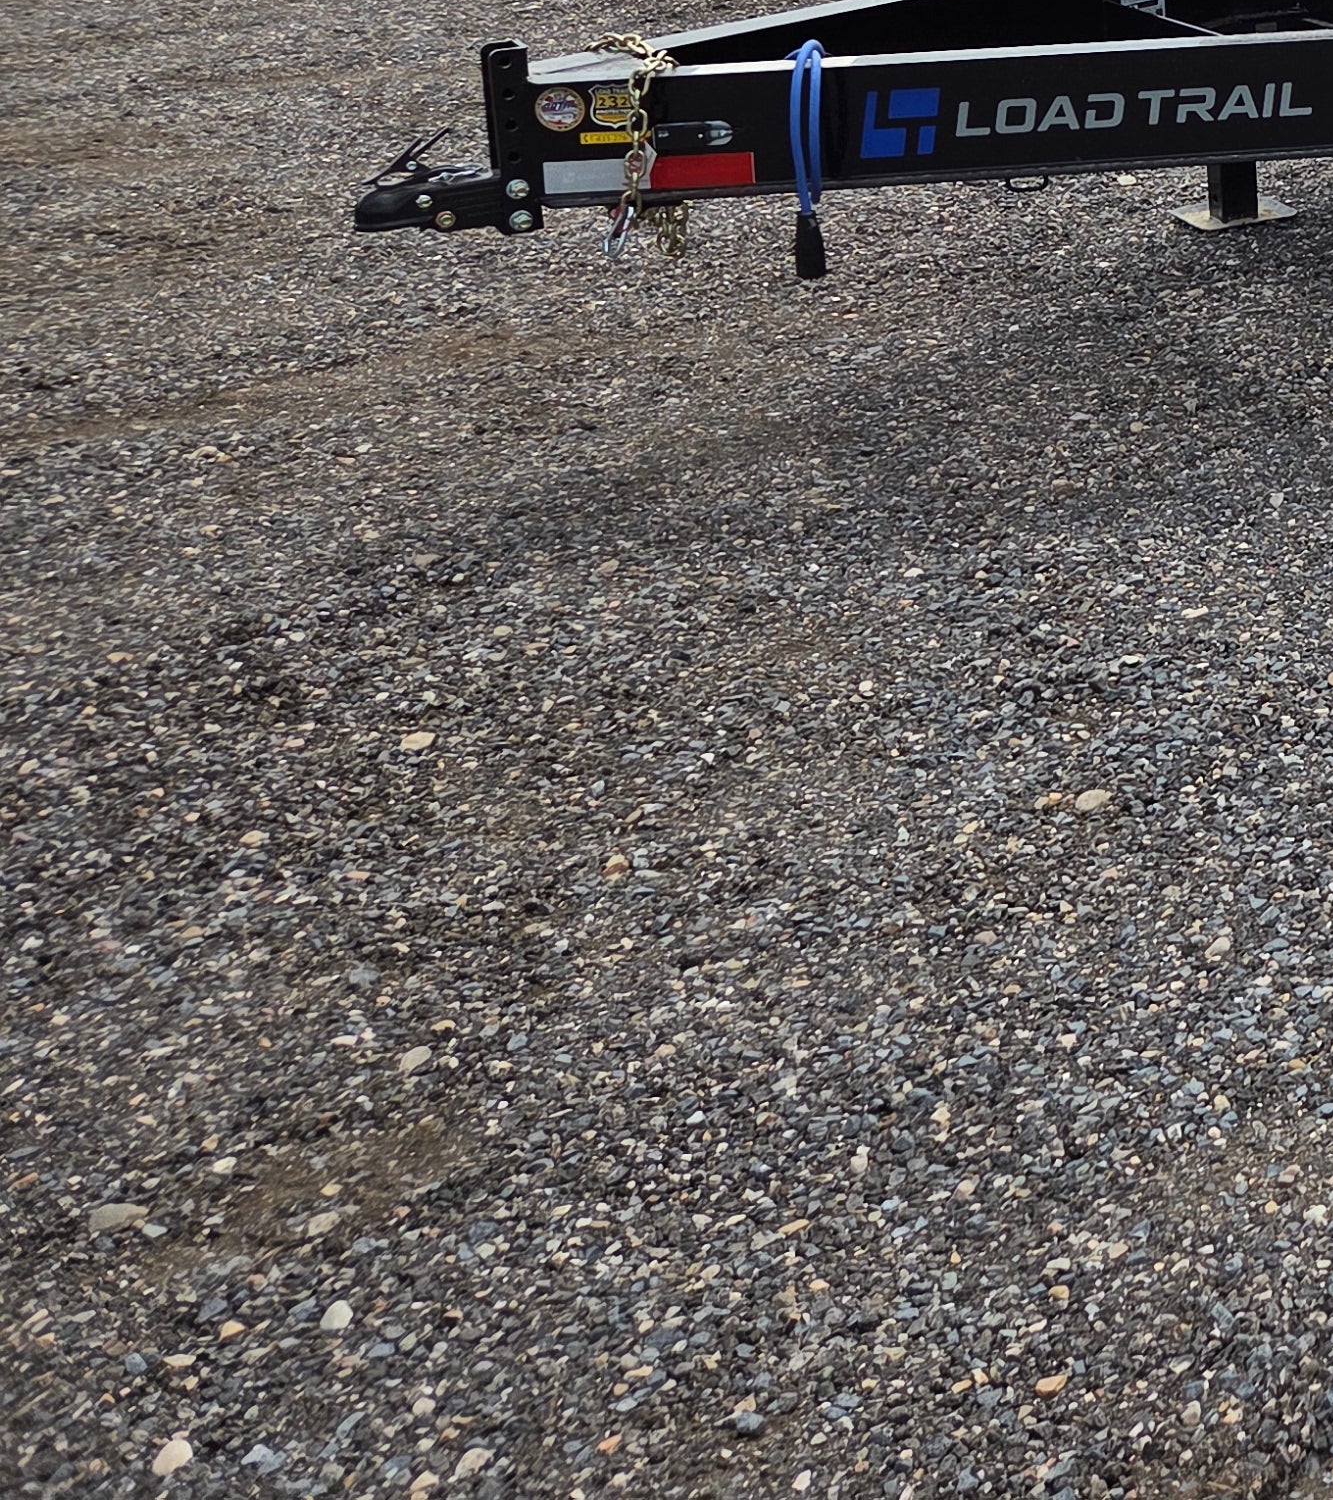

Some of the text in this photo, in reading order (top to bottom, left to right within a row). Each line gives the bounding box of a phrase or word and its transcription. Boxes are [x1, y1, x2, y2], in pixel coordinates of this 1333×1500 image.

[599, 96, 628, 107] 232
[955, 92, 1126, 137] LOAD
[1137, 82, 1313, 126] TRAIL
